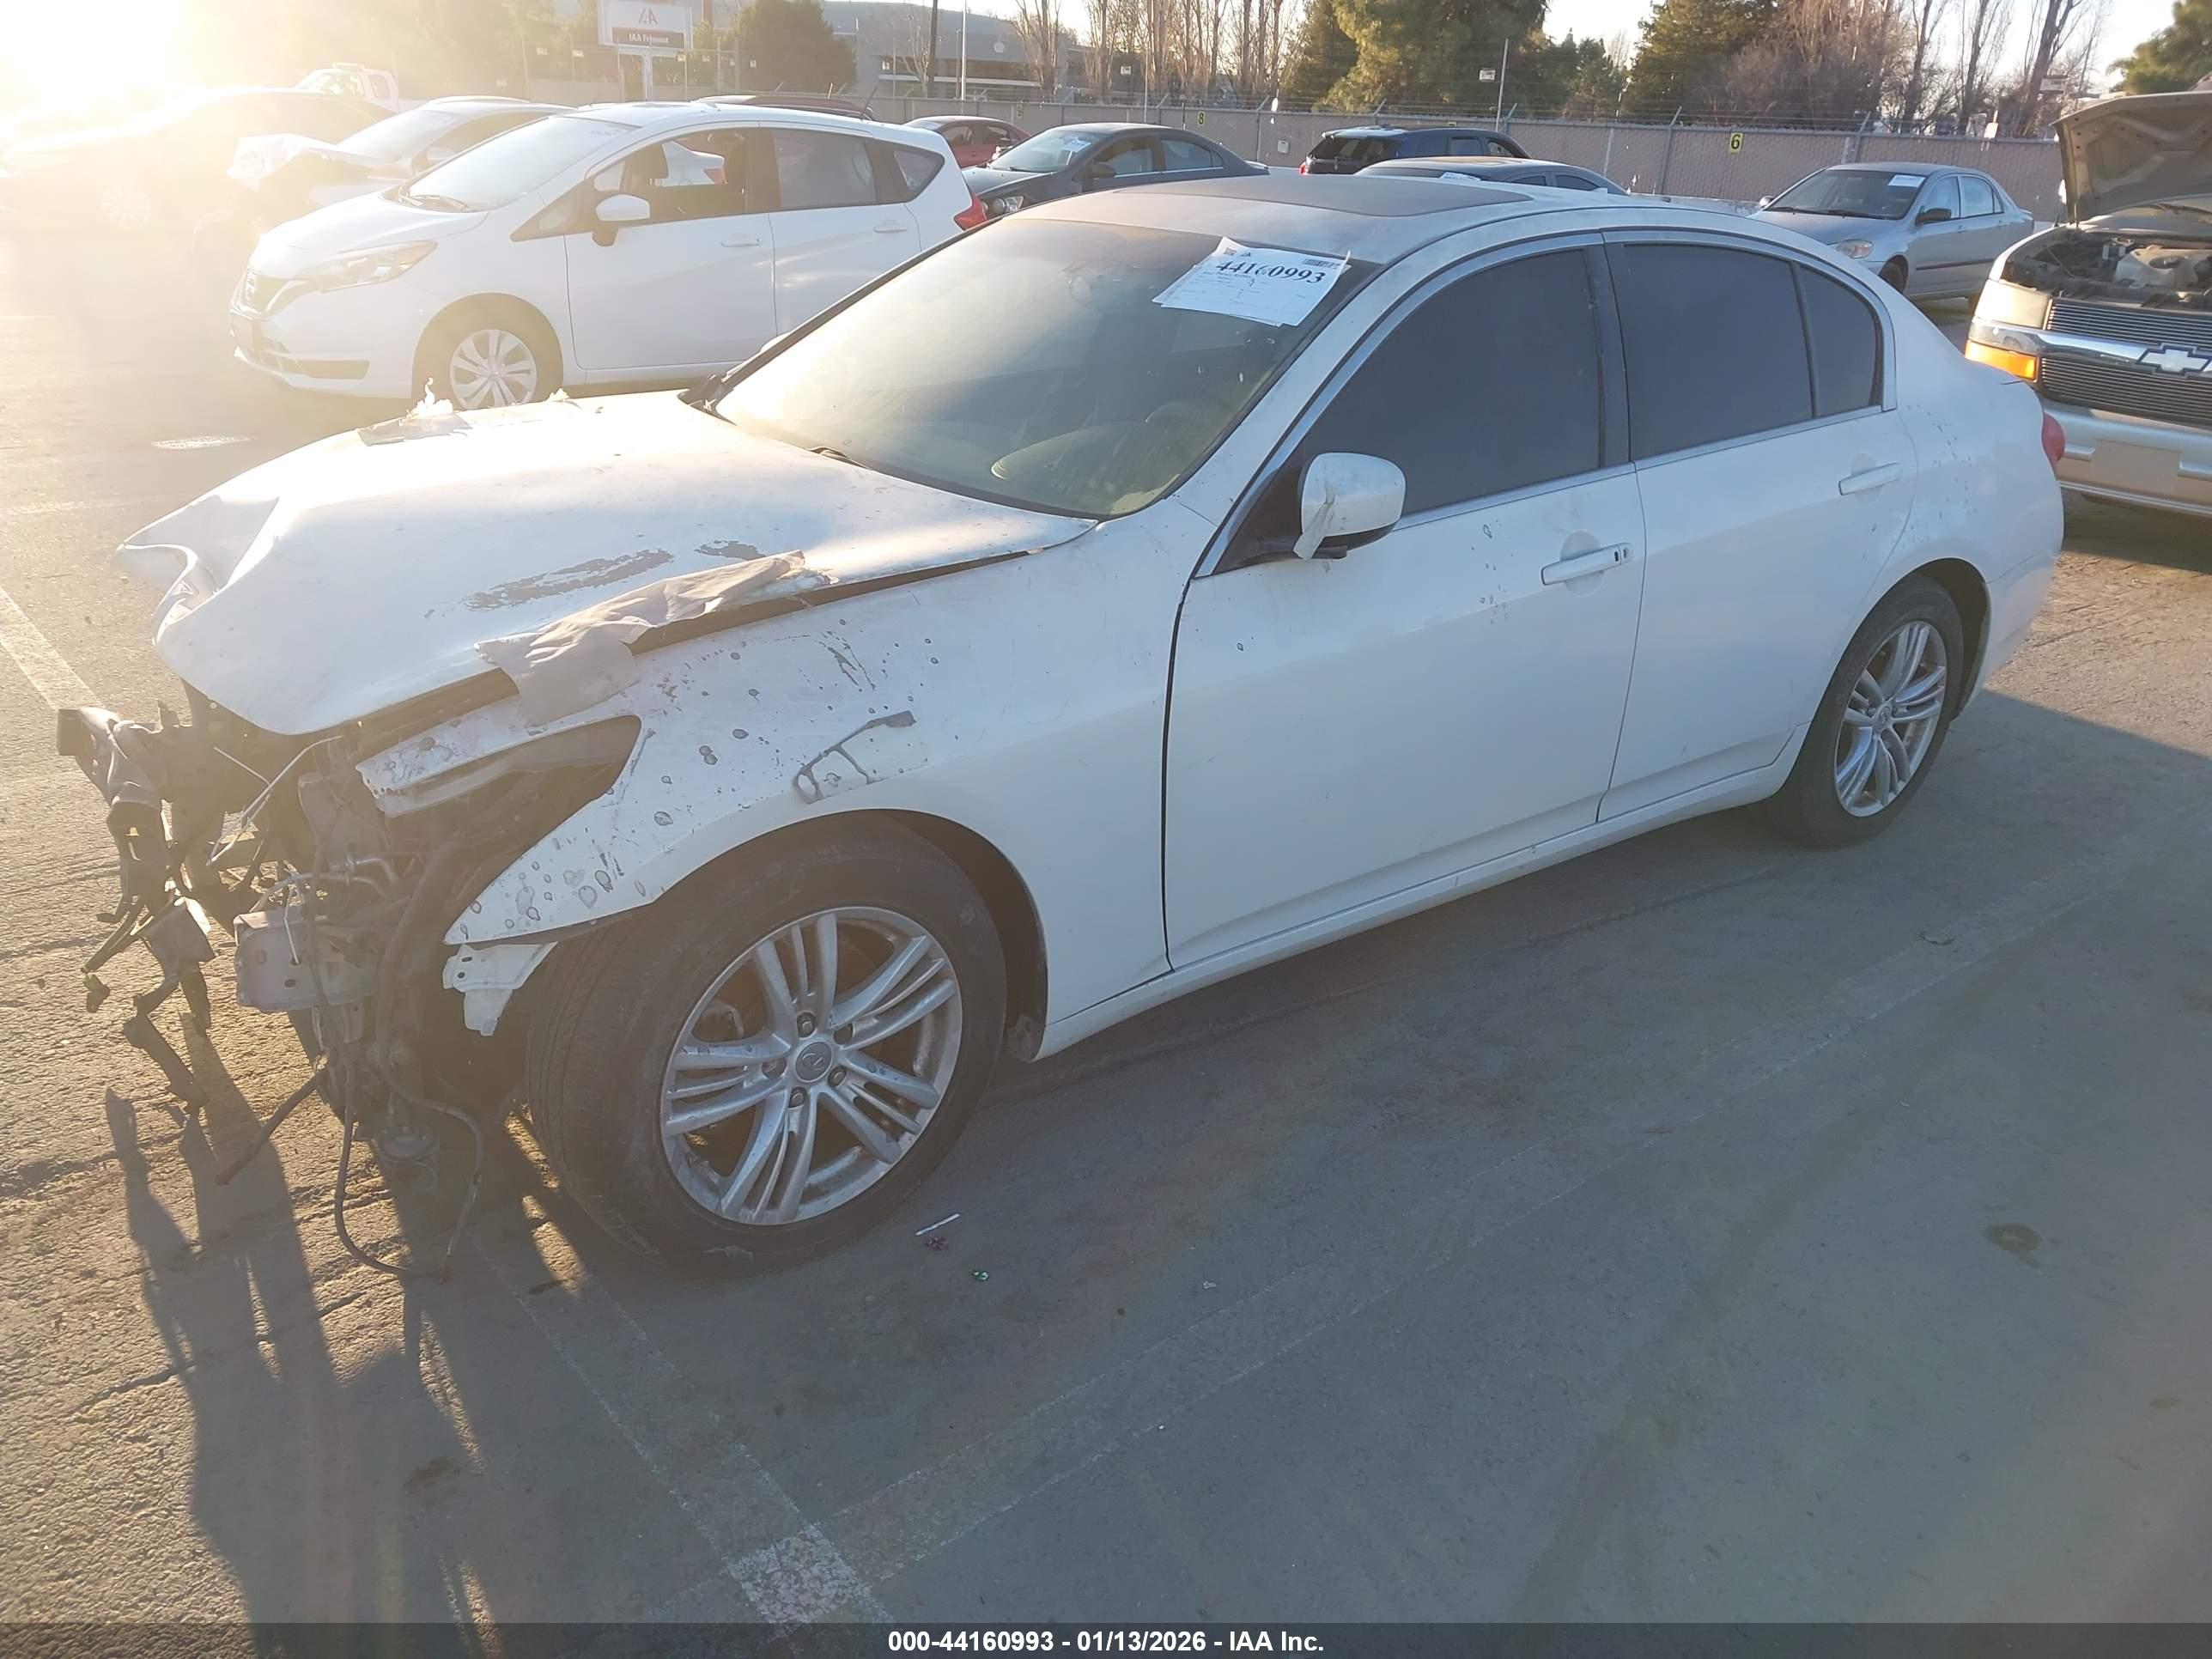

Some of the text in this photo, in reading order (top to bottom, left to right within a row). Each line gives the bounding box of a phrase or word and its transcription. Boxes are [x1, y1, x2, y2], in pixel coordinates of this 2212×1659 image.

[1198, 112, 1204, 125] 8
[1730, 133, 1741, 149] 6
[1215, 260, 1326, 283] 44160993
